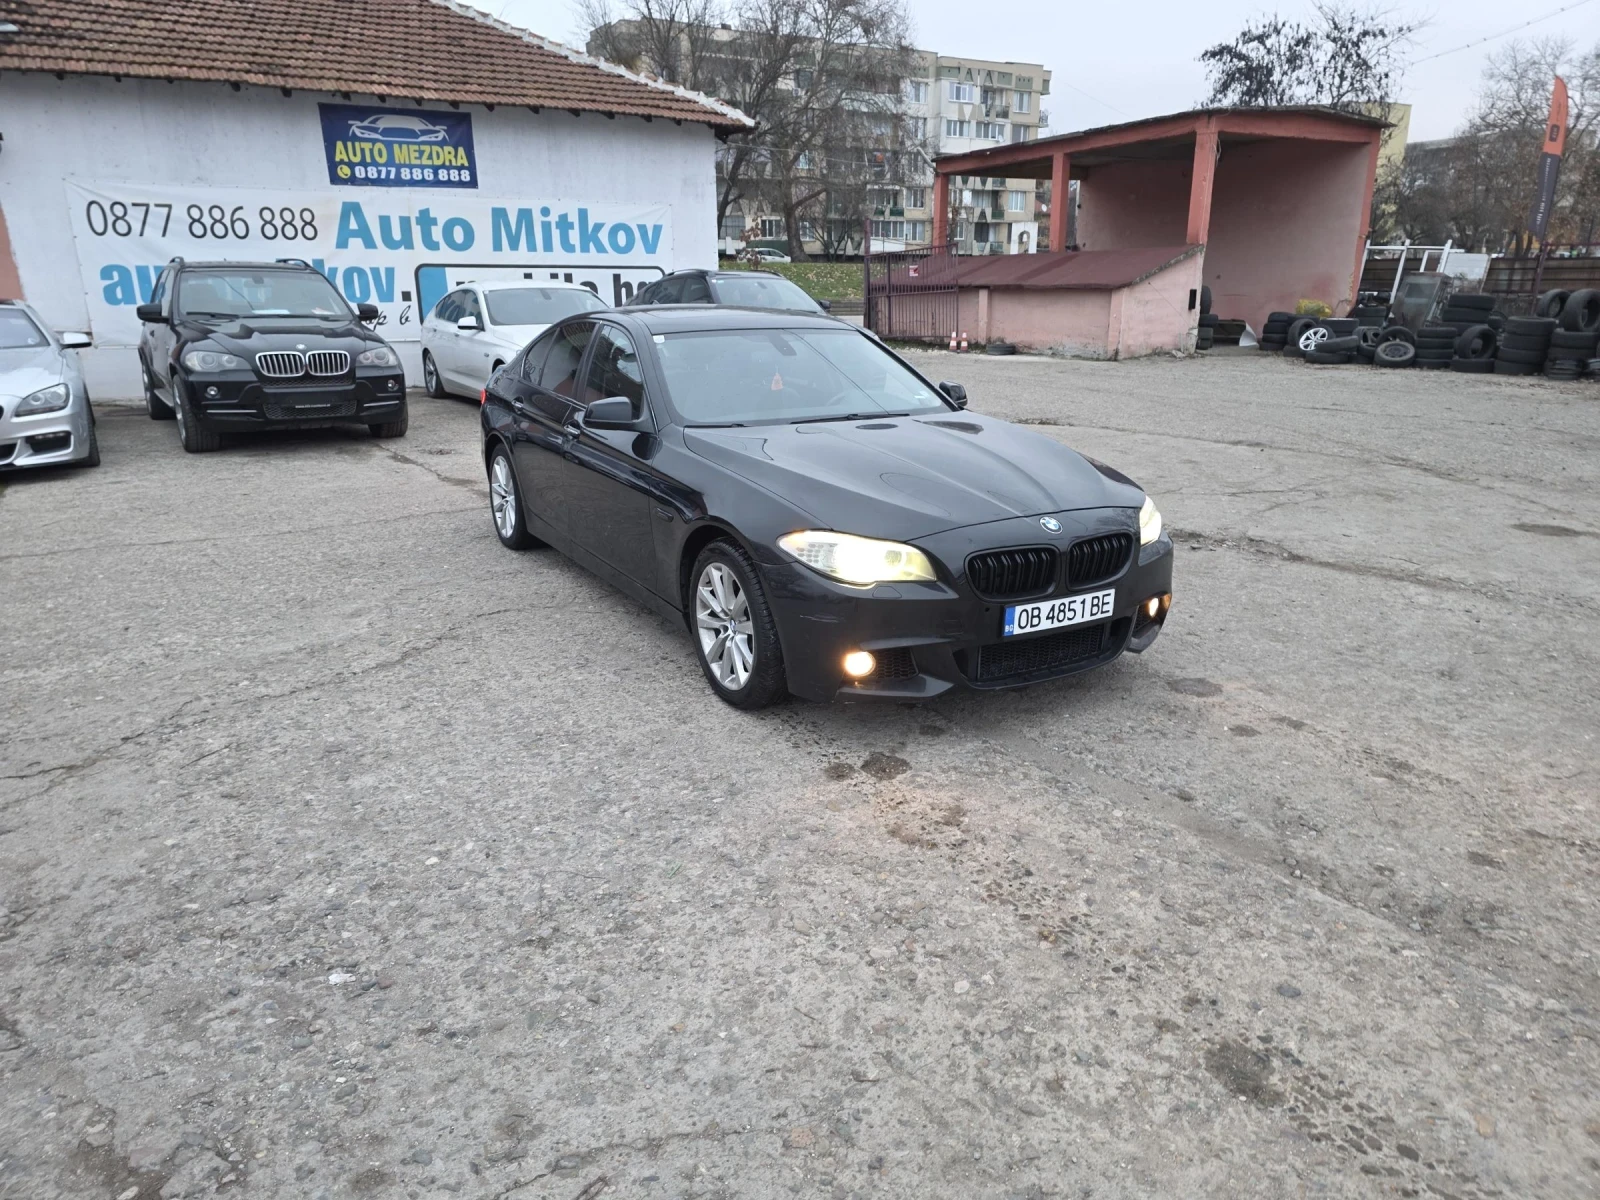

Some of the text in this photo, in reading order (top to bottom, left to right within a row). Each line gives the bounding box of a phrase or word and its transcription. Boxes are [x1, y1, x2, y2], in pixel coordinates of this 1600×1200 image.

[335, 141, 469, 166] AUTO MEZDRA
[354, 166, 470, 181] 0877 886 888
[86, 200, 318, 241] 0877 886 888
[335, 201, 663, 254] Auto Mitkov
[1018, 593, 1112, 629] OB 4851 BE
[1005, 624, 1014, 633] BG
